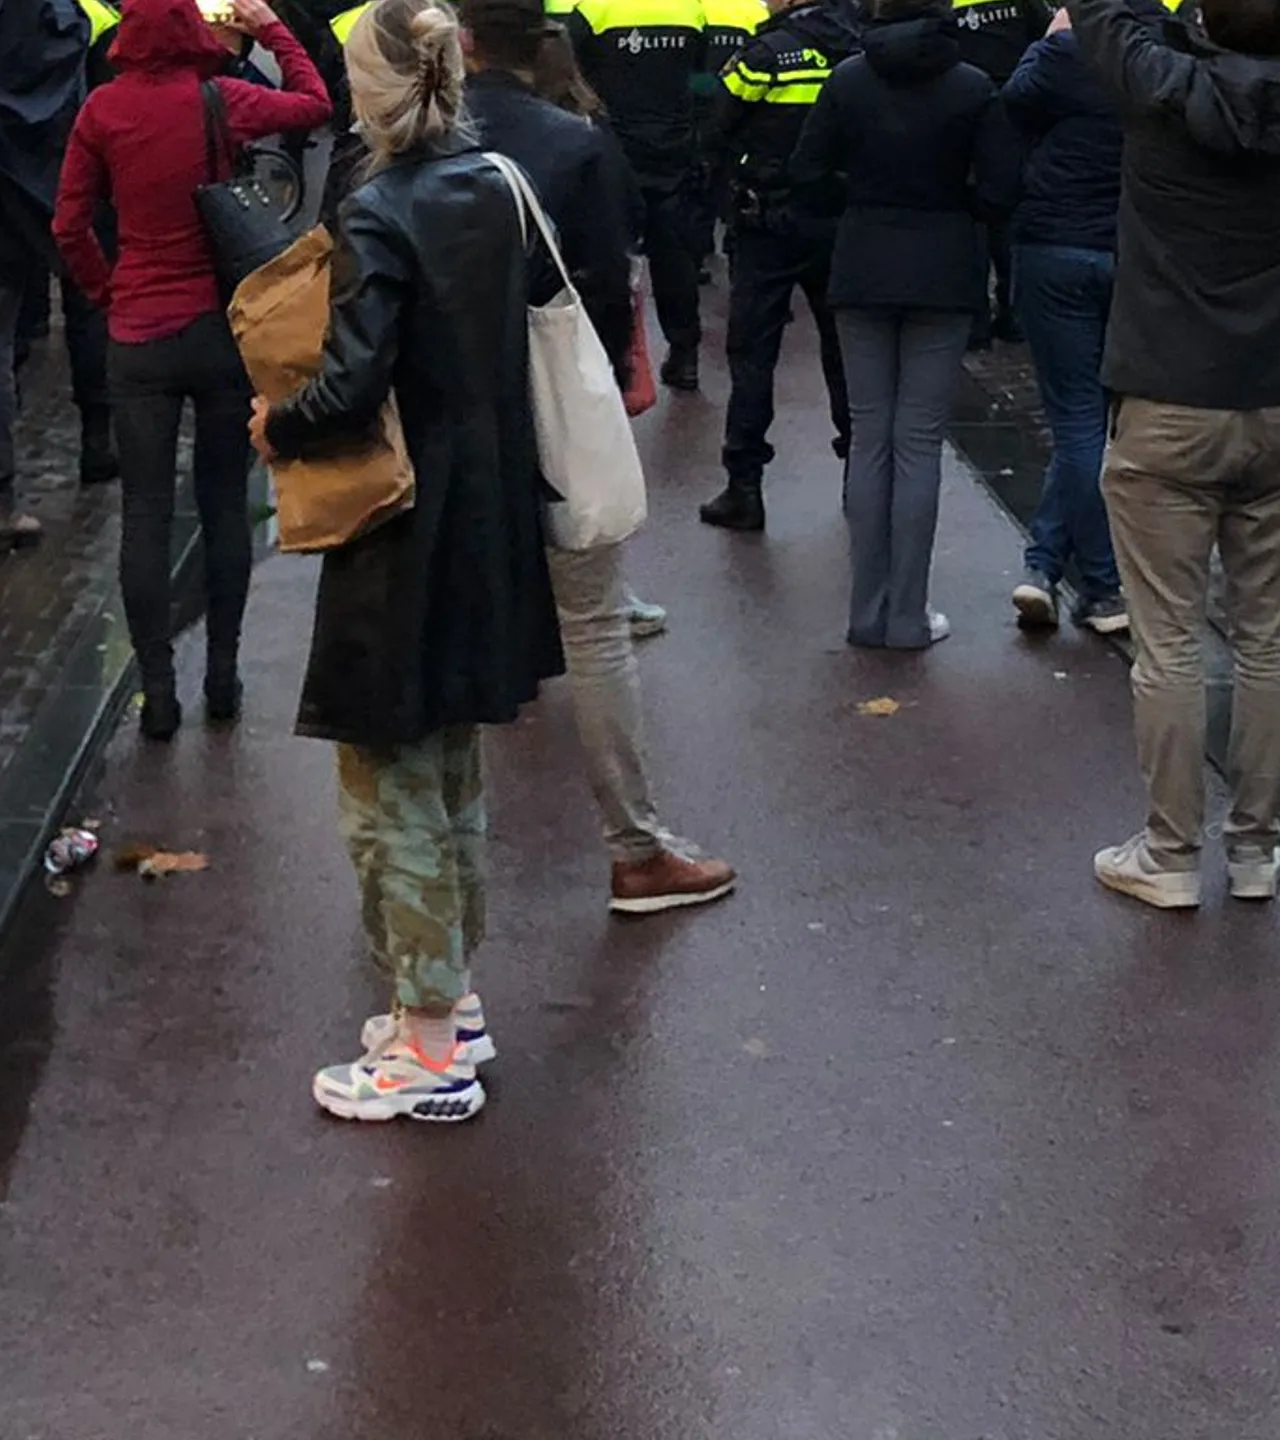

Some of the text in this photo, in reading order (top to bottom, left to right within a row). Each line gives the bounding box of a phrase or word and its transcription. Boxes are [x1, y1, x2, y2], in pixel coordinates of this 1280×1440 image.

[957, 7, 1017, 30] POLITIE
[618, 28, 686, 53] POLITIE
[713, 35, 744, 46] ITIE
